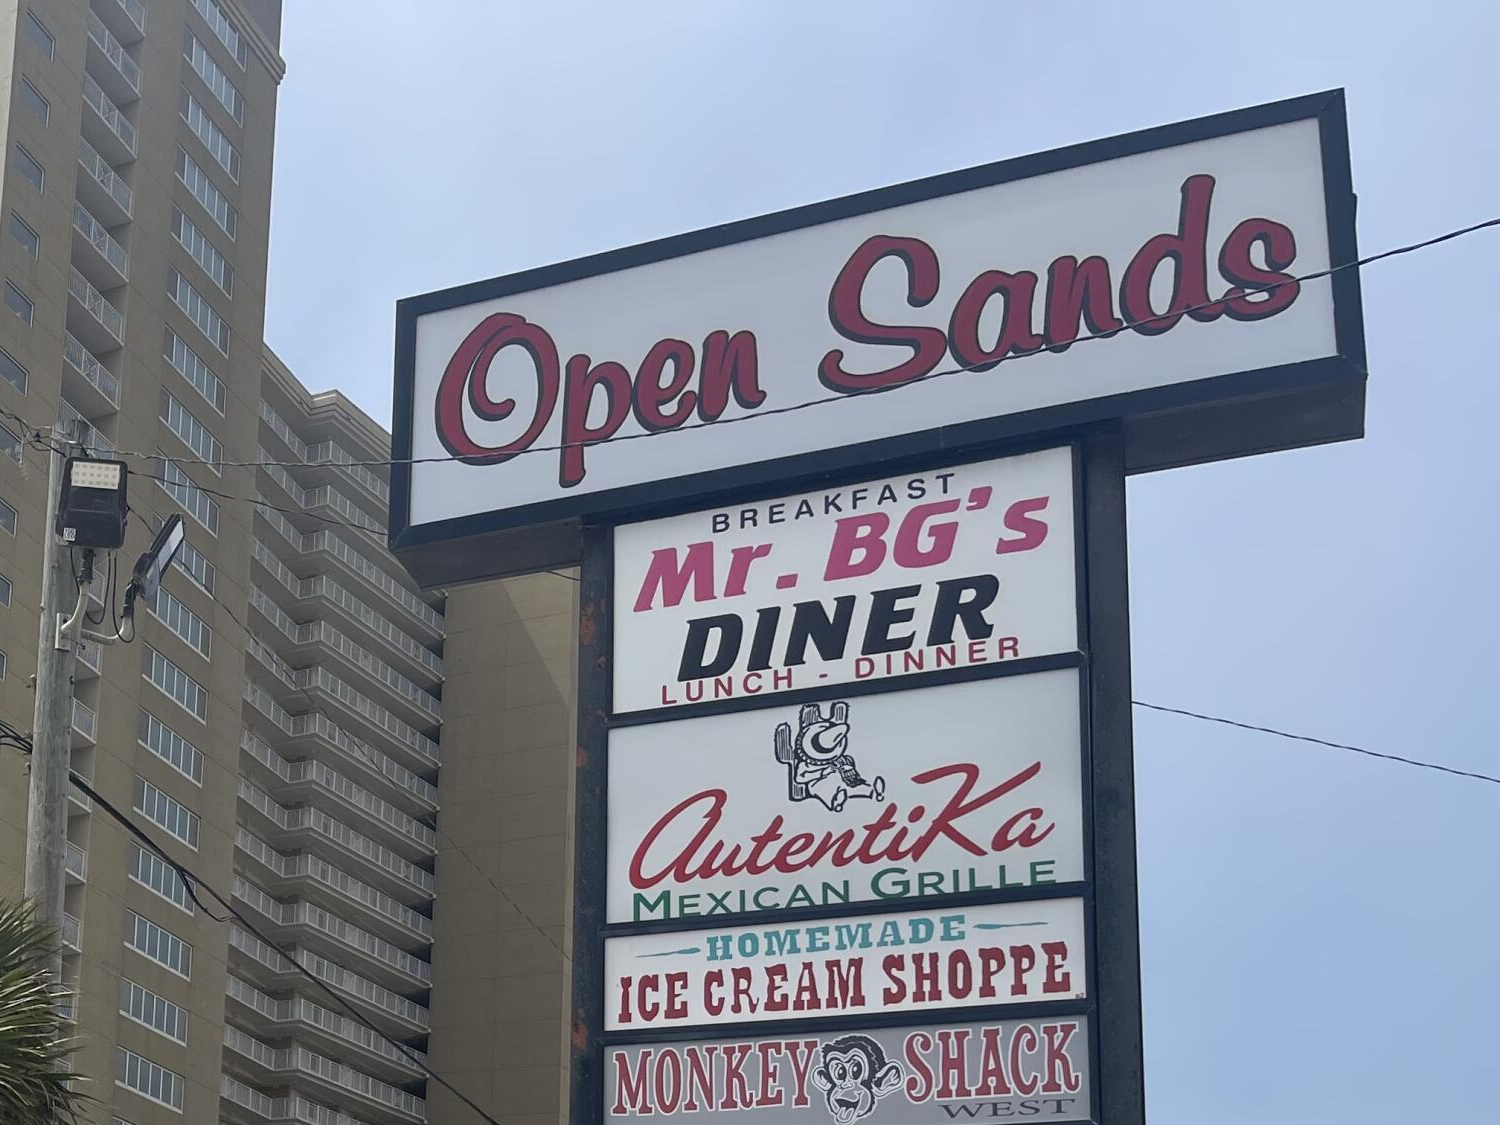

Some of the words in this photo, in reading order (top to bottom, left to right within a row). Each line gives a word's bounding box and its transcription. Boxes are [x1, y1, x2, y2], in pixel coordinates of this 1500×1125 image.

[435, 312, 766, 487] Open
[818, 173, 1301, 394] Sands
[712, 473, 955, 533] BREAKFAST
[633, 541, 798, 612] Mr.
[823, 486, 1049, 581] BG's
[677, 574, 999, 682] DINER
[661, 668, 793, 705] LUNCH
[854, 637, 1020, 679] DINNER
[632, 880, 850, 922] MEXICAN
[871, 860, 1057, 899] GRILLE
[706, 914, 967, 961] HOMEMADE
[618, 970, 689, 1024] ICE
[703, 957, 866, 1017] CREAM
[882, 941, 1071, 1006] SHOPPE
[610, 1039, 820, 1117] MONKEY
[904, 1022, 1082, 1104] SHACK
[939, 1098, 1076, 1120] WEST
